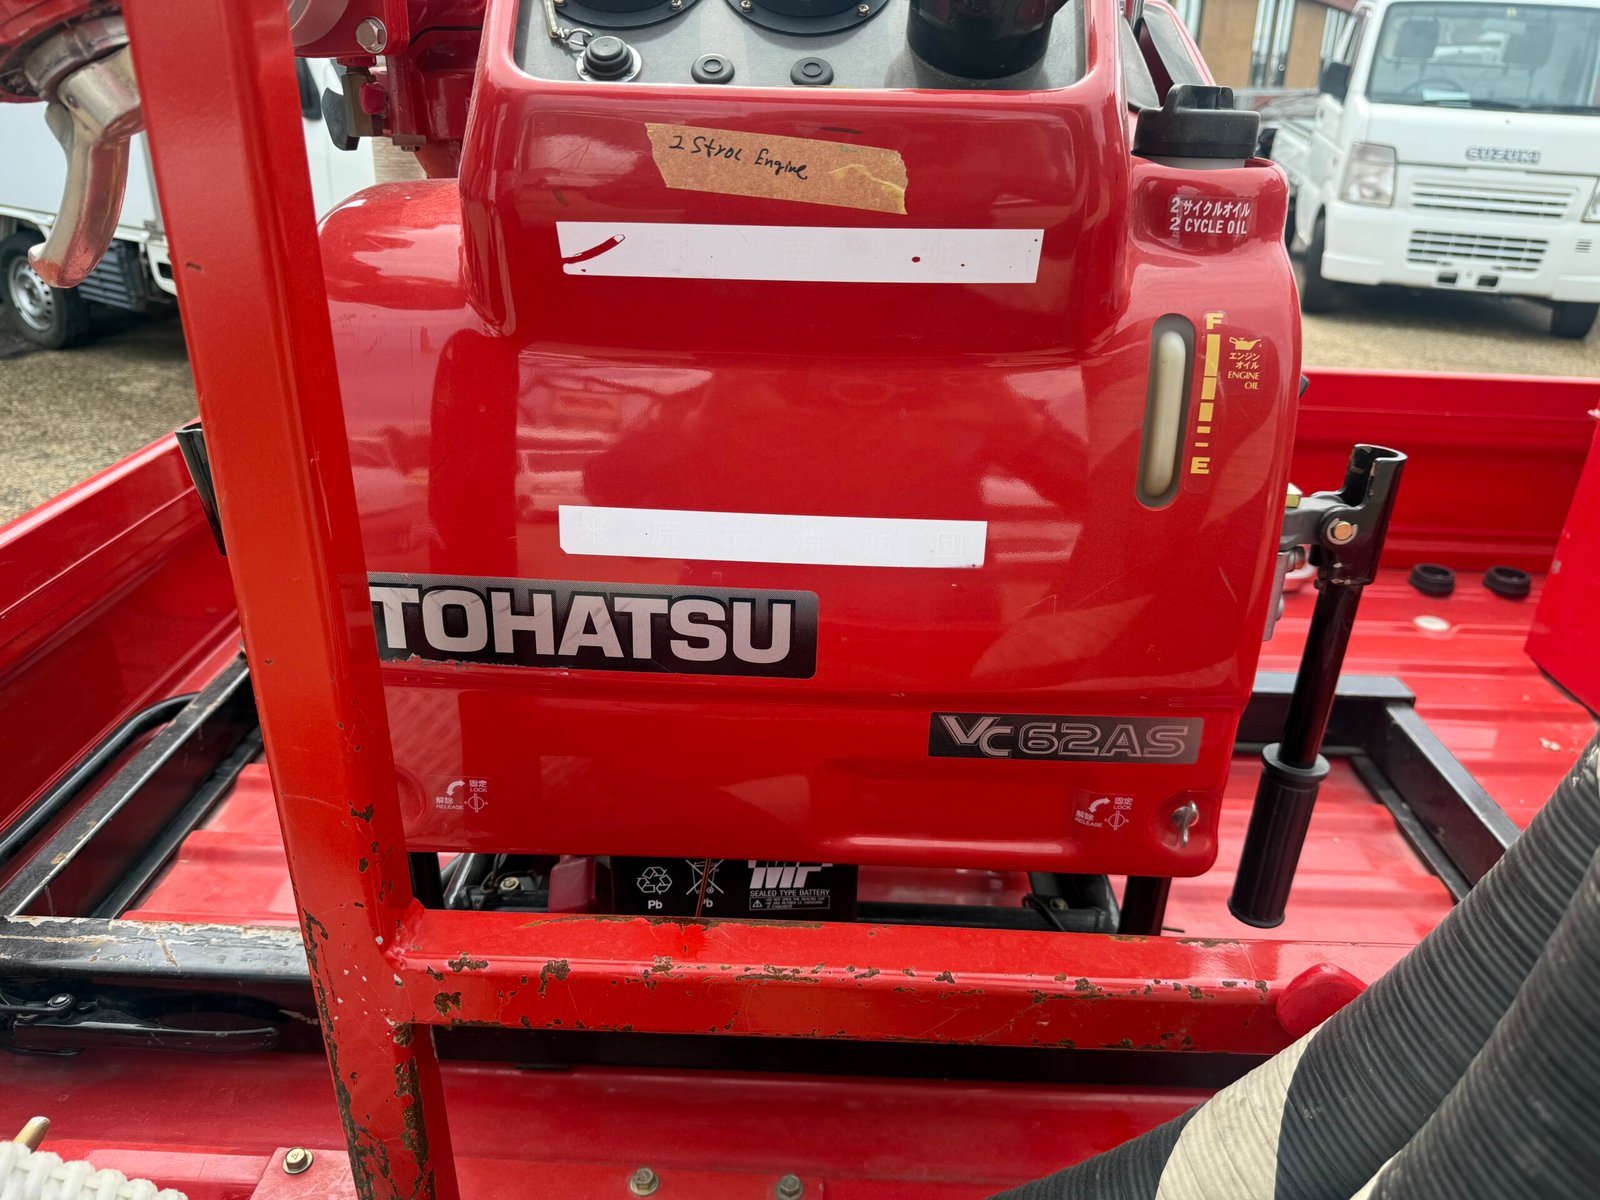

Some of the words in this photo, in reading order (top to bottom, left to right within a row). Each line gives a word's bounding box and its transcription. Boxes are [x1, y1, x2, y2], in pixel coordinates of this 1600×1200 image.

[755, 148, 808, 180] Engine
[1170, 197, 1250, 217] 2サイクルオイル
[1169, 217, 1180, 231] 2
[1184, 218, 1224, 234] CYCLE
[1227, 220, 1248, 235] OIL
[1206, 312, 1224, 330] F
[1235, 361, 1259, 369] オイル
[1227, 371, 1260, 380] ENGINE
[1244, 382, 1260, 390] OIL
[1190, 456, 1211, 474] E
[369, 586, 792, 664] TOHATSU
[1075, 817, 1102, 827] RELEASE
[750, 889, 777, 897] SEALED
[647, 900, 663, 910] Pb
